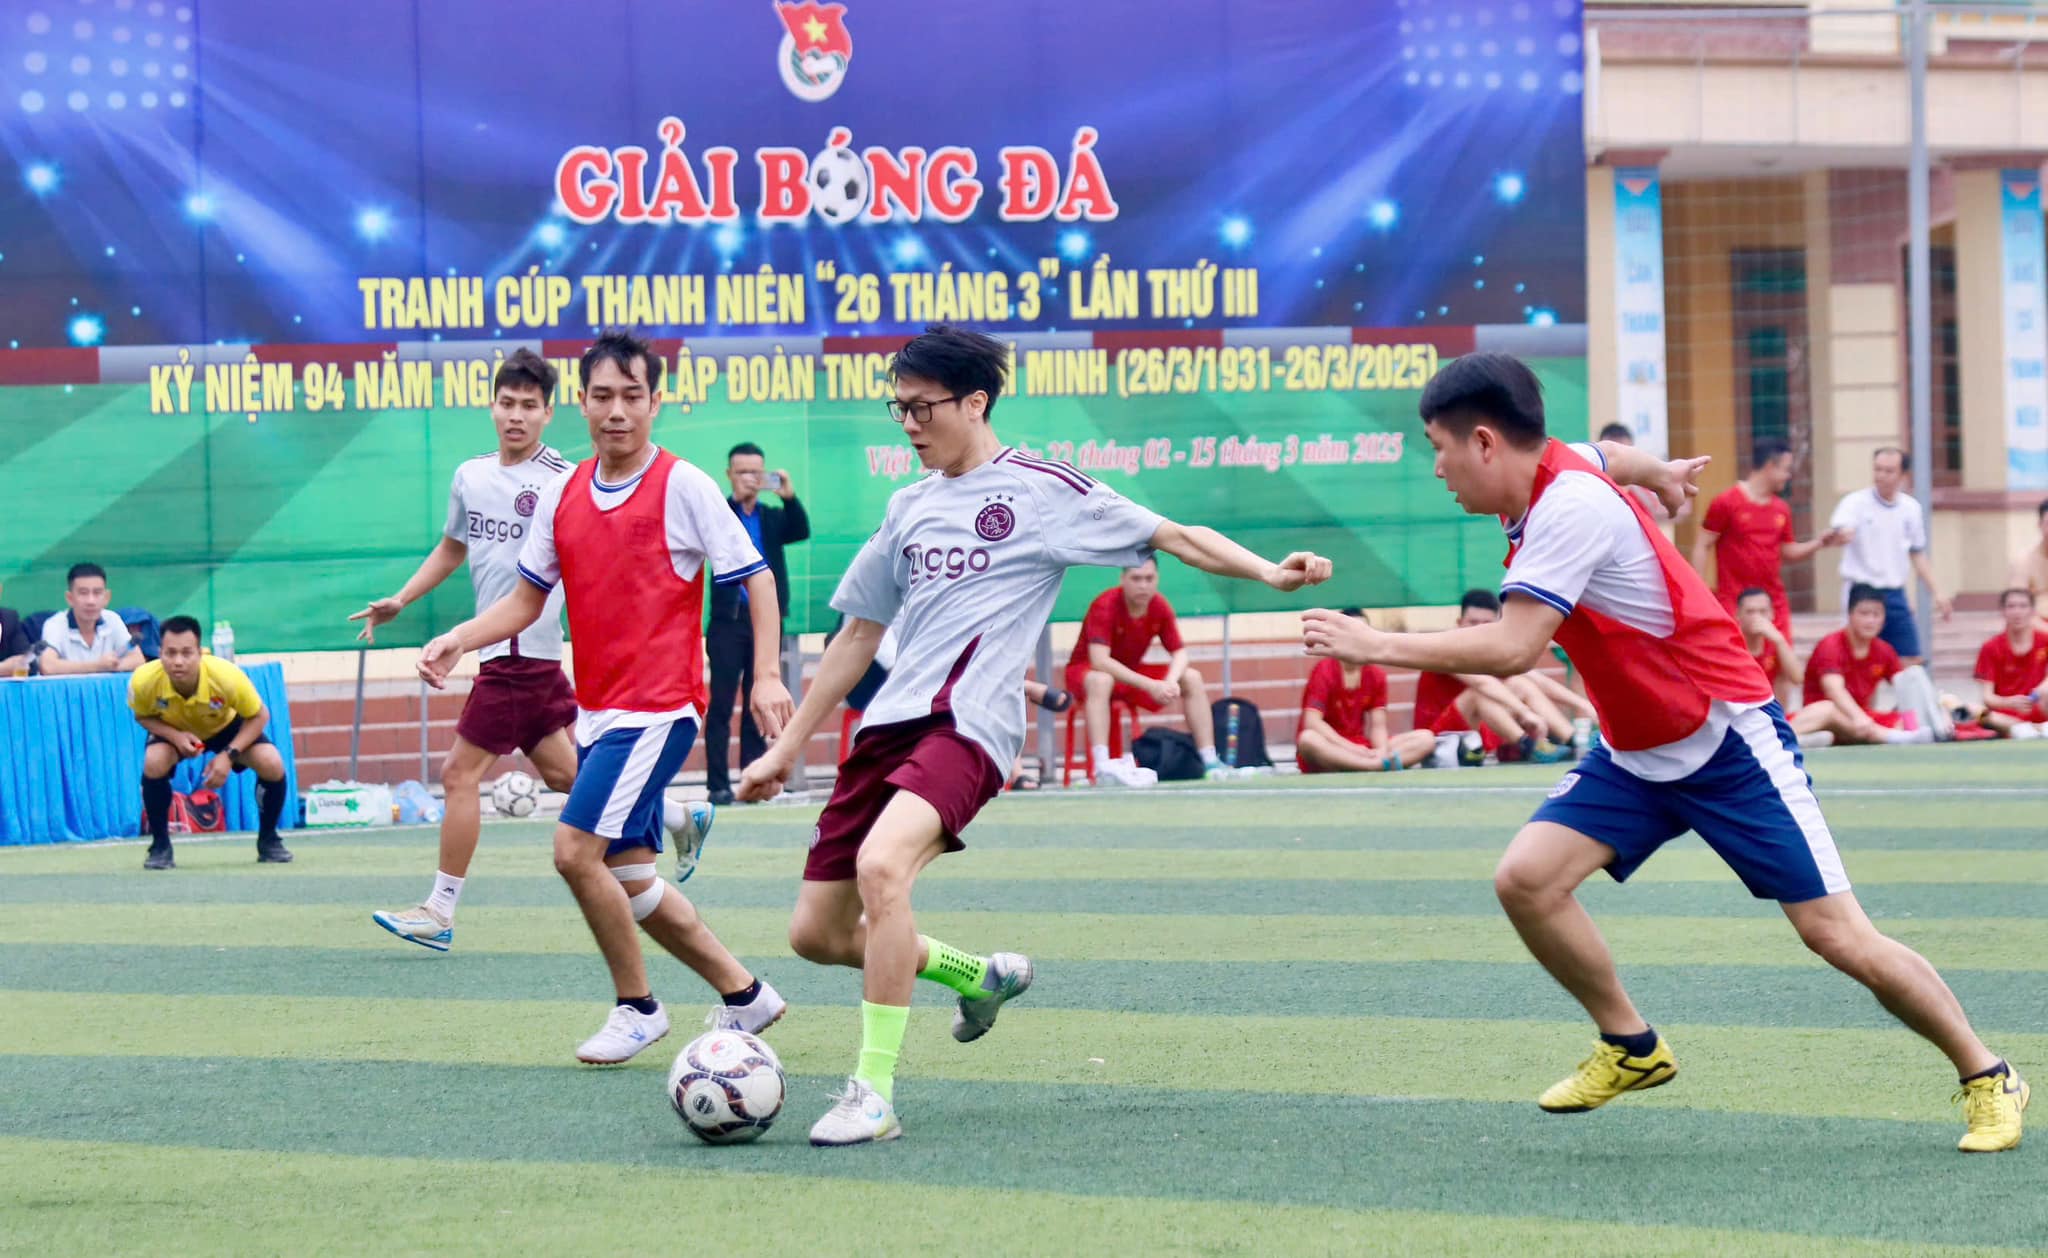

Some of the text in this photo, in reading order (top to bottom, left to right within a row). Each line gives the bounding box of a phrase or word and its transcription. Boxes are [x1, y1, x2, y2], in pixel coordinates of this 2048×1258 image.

[555, 116, 1119, 225] GIẢI BÓNG ĐÁ
[357, 277, 486, 330] TRANH
[494, 264, 572, 328] CÚP
[580, 274, 706, 327] THANH
[715, 263, 806, 325] NIÊN
[888, 261, 1009, 322] THÁNG
[1069, 252, 1139, 320] LẦN
[1146, 258, 1218, 319] THỨ
[1222, 268, 1258, 318] III
[150, 346, 195, 414] KỶ
[204, 352, 295, 423] NIỆM
[302, 362, 345, 411] 94
[354, 350, 434, 410] NĂM
[726, 345, 816, 402] ĐOÀN
[1025, 349, 1108, 397] MINH
[1116, 343, 1438, 398] (26/3/1931-26/3/2025)
[866, 445, 912, 480] Việt
[1079, 438, 1142, 476] tháng
[1143, 437, 1172, 469] 02
[1189, 435, 1217, 468] 15
[1219, 435, 1282, 473] tháng
[1283, 434, 1299, 465] 3
[1302, 433, 1349, 465] năm
[1351, 431, 1404, 464] 2025
